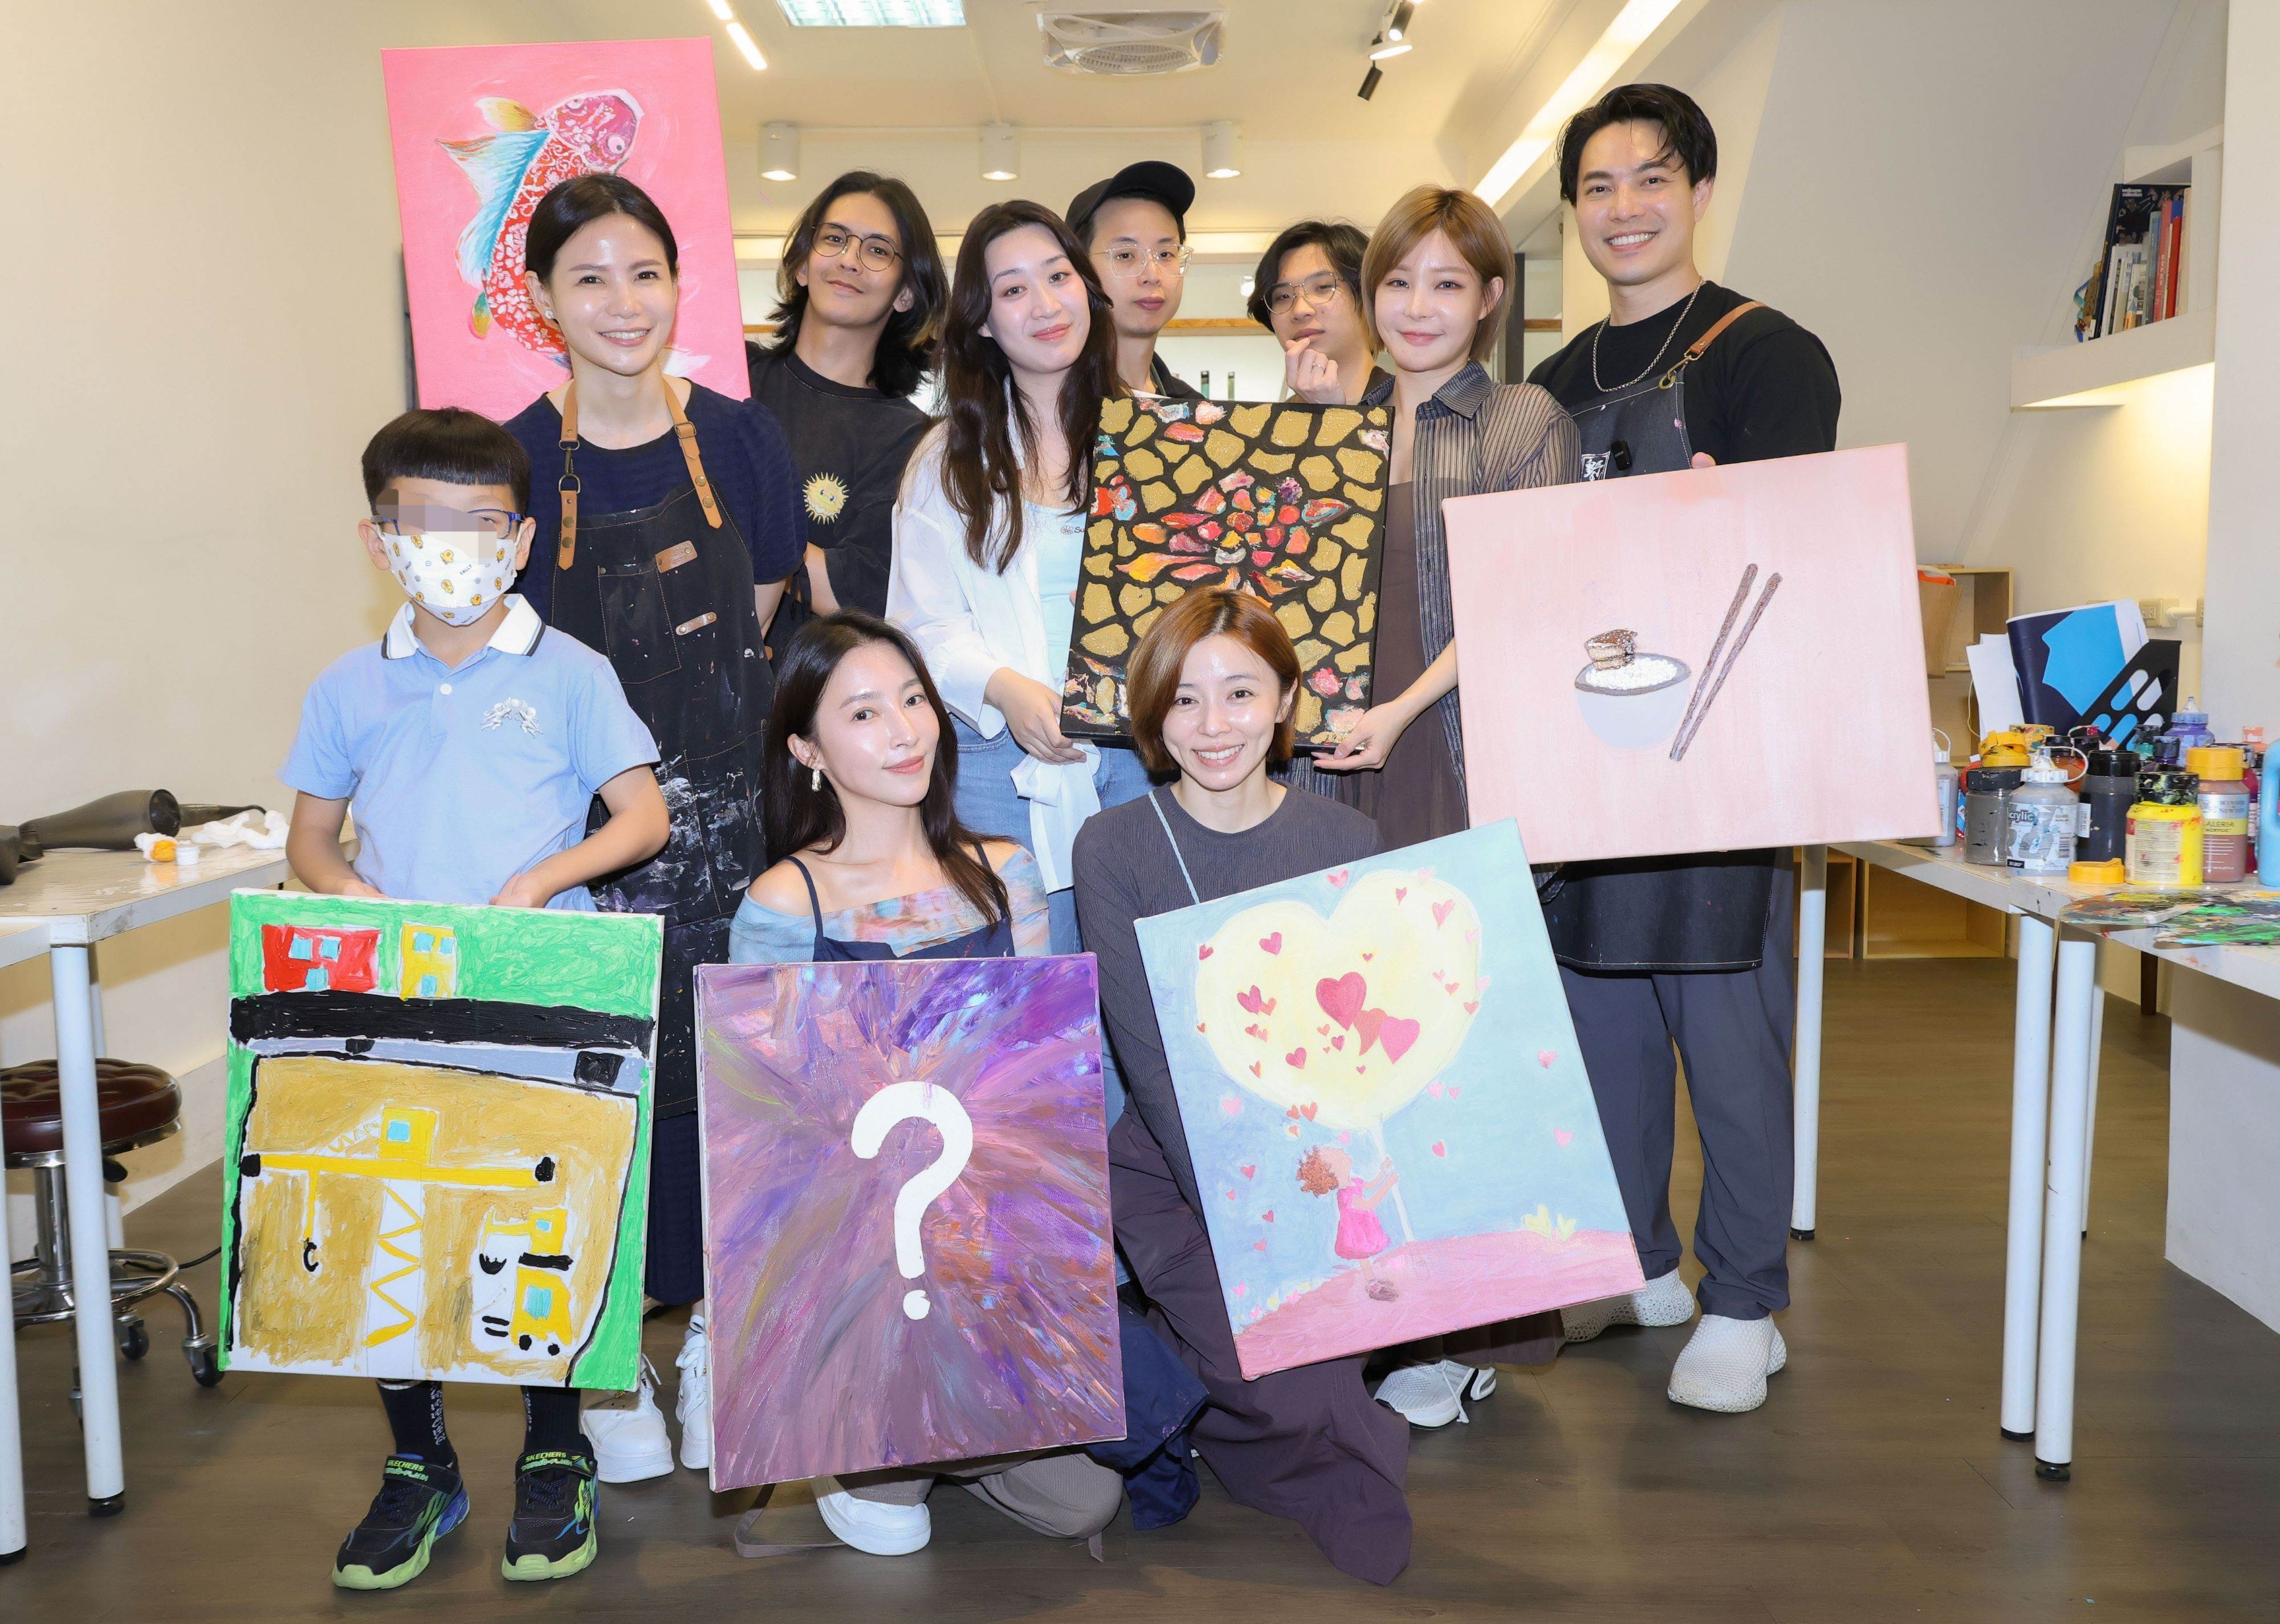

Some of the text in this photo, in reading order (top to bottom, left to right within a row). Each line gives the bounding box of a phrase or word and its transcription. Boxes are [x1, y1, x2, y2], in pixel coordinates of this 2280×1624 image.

[2008, 810, 2034, 823] crylic
[526, 1451, 567, 1462] SKECHERS
[387, 1459, 425, 1472] SKECHERS
